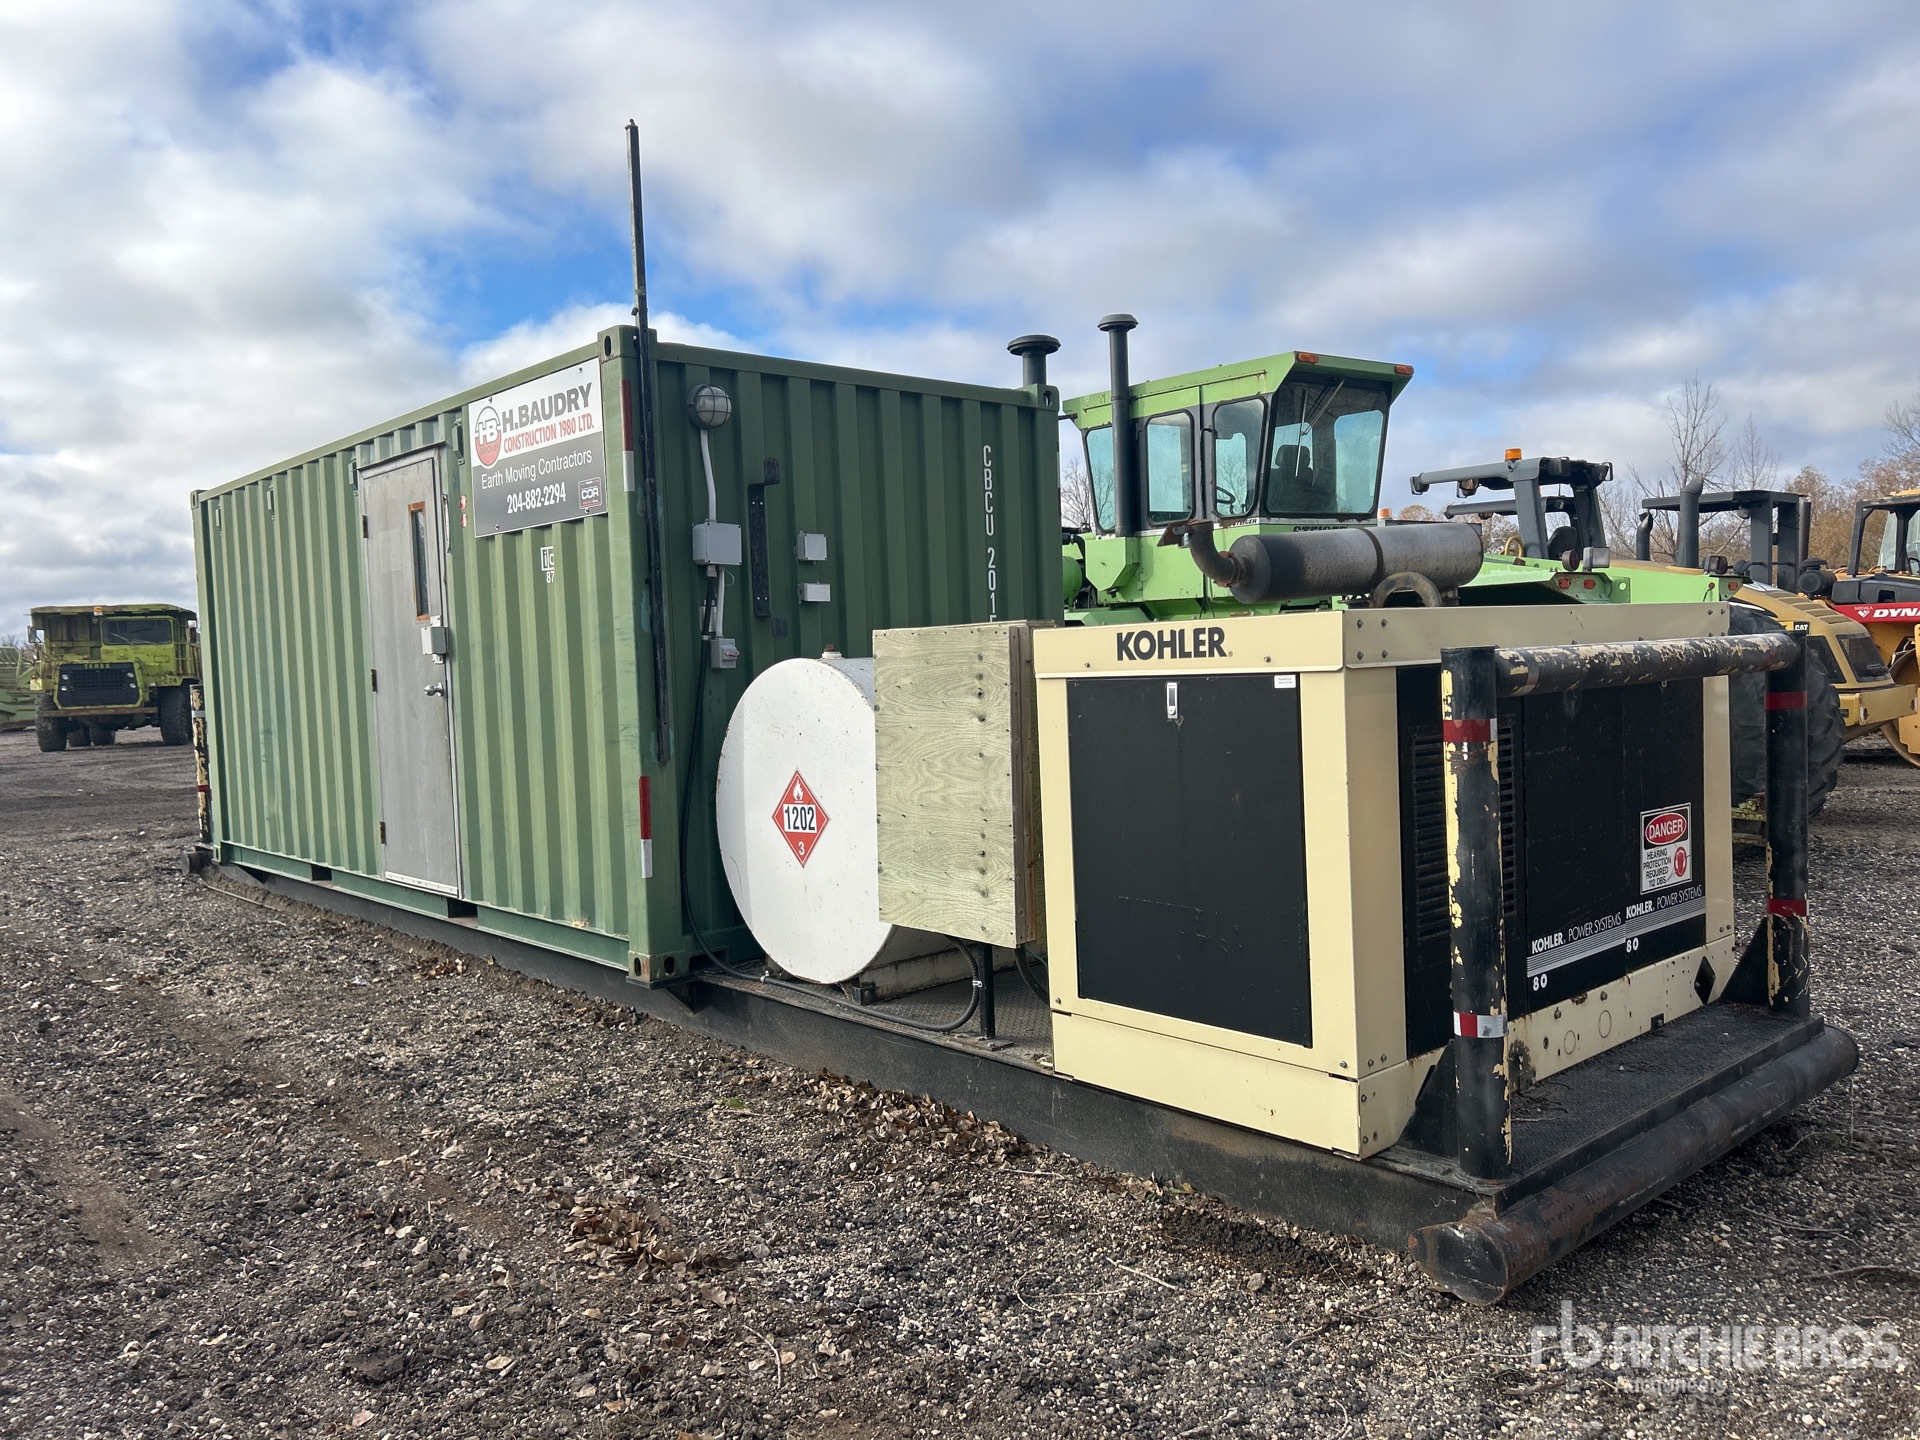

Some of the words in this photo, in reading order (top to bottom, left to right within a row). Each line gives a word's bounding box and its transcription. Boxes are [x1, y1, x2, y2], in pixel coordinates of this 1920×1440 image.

[504, 423, 557, 454] CONSTRUCTION
[559, 418, 577, 438] 1980
[578, 413, 595, 433] LTD.
[481, 470, 504, 490] Earth
[505, 463, 537, 485] Moving
[538, 449, 593, 476] Contractors
[507, 482, 567, 514] 204-882-2294
[983, 444, 994, 536] CBCU
[546, 570, 555, 584] 87
[1873, 607, 1920, 618] DYN
[1116, 626, 1228, 662] KOHLER
[784, 806, 816, 831] 1202
[1648, 818, 1683, 840] DANGER
[798, 841, 805, 856] 3
[1646, 847, 1668, 860] HEARING
[1643, 856, 1672, 870] PROTECTION
[1645, 866, 1669, 879] REQUIRED
[1625, 900, 1653, 919] KOHLER
[1656, 892, 1678, 910] POWER
[1678, 884, 1702, 903] SYSTEMS
[1531, 932, 1563, 955] KOHLER
[1568, 921, 1594, 942] POWER
[1594, 911, 1622, 934] SYSTEMS
[1626, 937, 1639, 953] 80
[1532, 973, 1548, 991] 80
